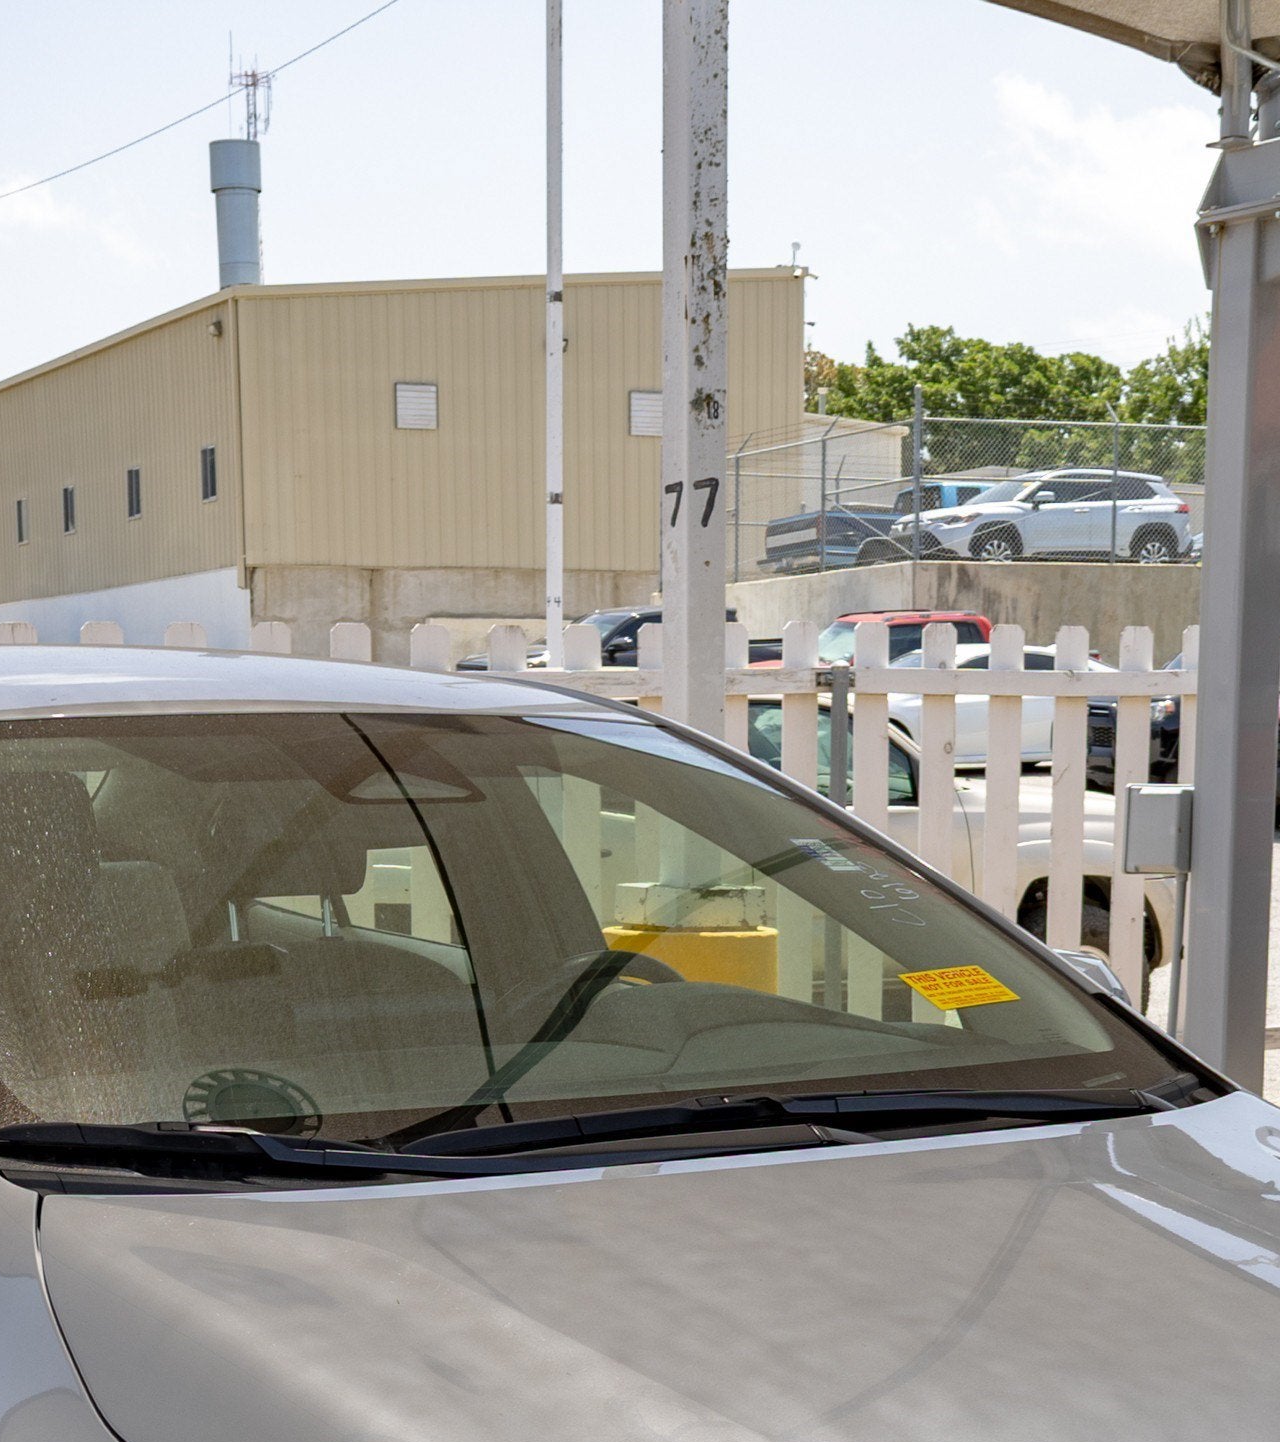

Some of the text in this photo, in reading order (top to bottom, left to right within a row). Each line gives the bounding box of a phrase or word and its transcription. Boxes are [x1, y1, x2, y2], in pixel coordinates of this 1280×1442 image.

[905, 967, 984, 985] THIS VEHICLE
[943, 980, 964, 988] FOR
[965, 976, 993, 985] SALE
